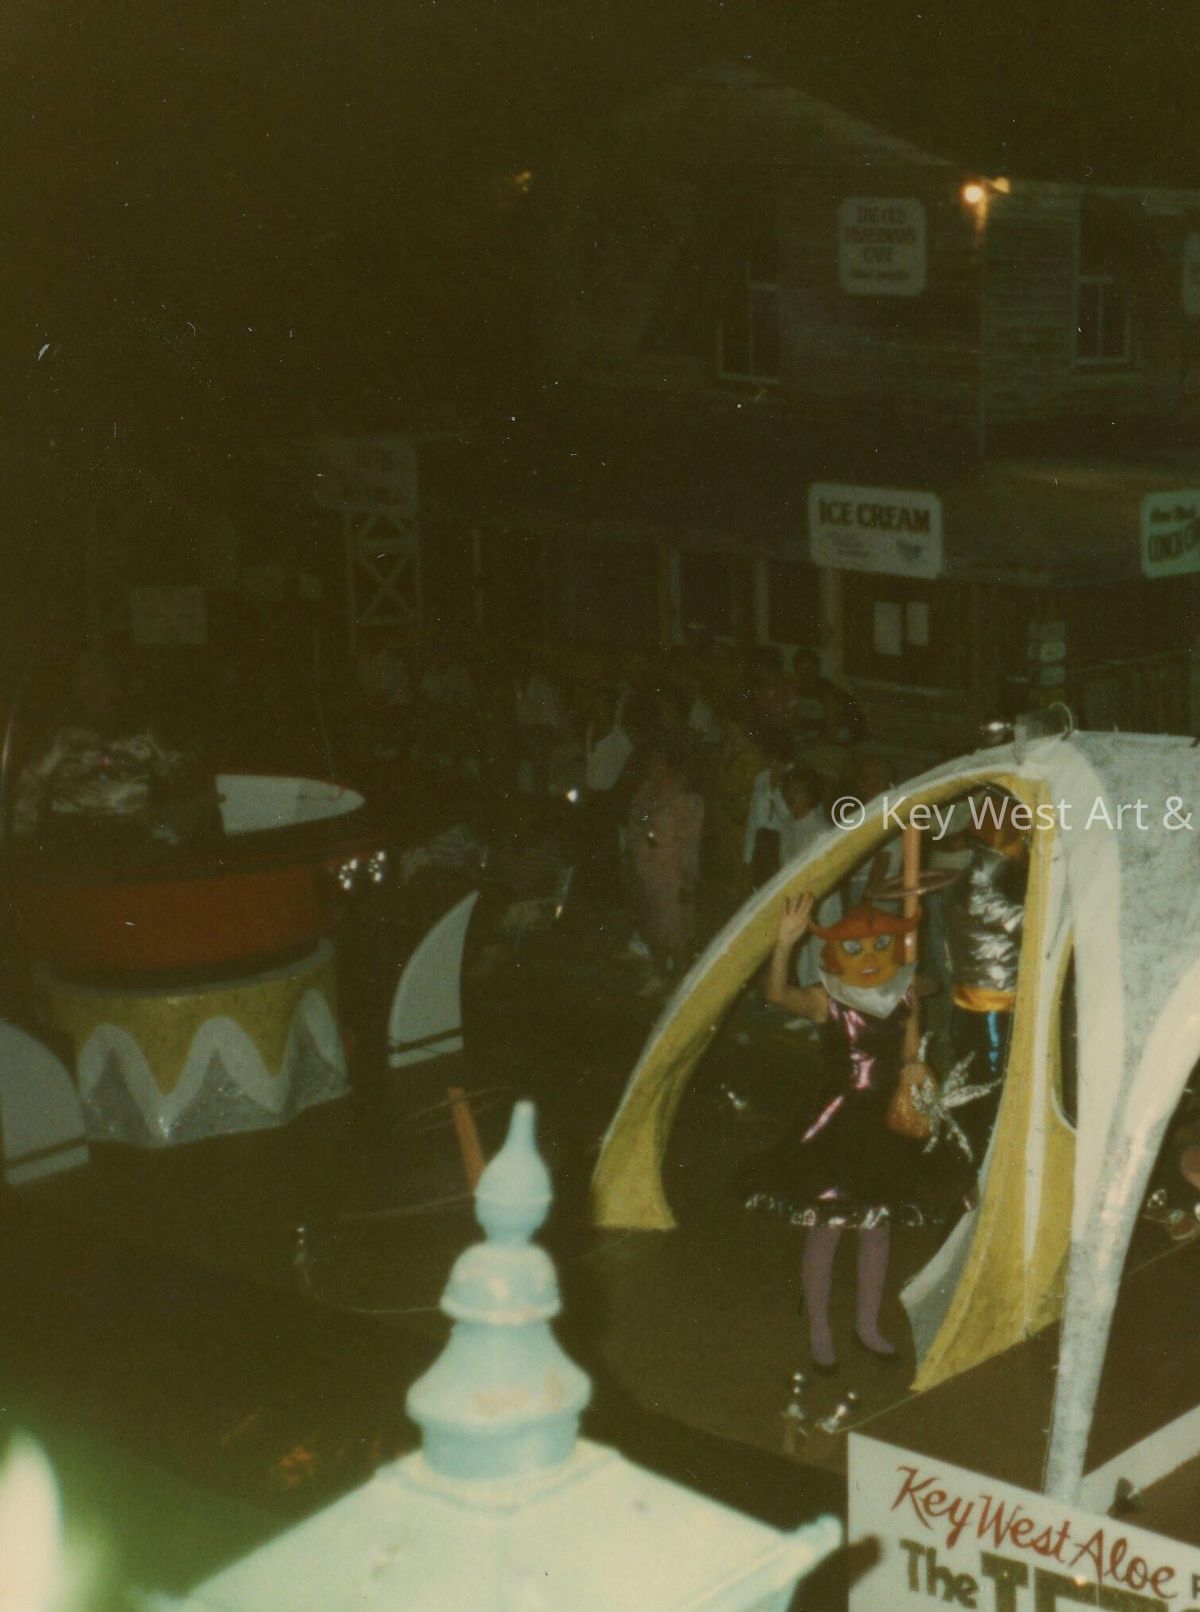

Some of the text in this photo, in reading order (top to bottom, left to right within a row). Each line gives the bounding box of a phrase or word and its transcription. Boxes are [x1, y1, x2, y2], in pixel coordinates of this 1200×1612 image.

[820, 499, 930, 534] ICE CREAM
[891, 1466, 974, 1549] Key
[977, 1494, 1072, 1565] West
[1067, 1528, 1179, 1599] Aloe
[899, 1537, 979, 1610] The
